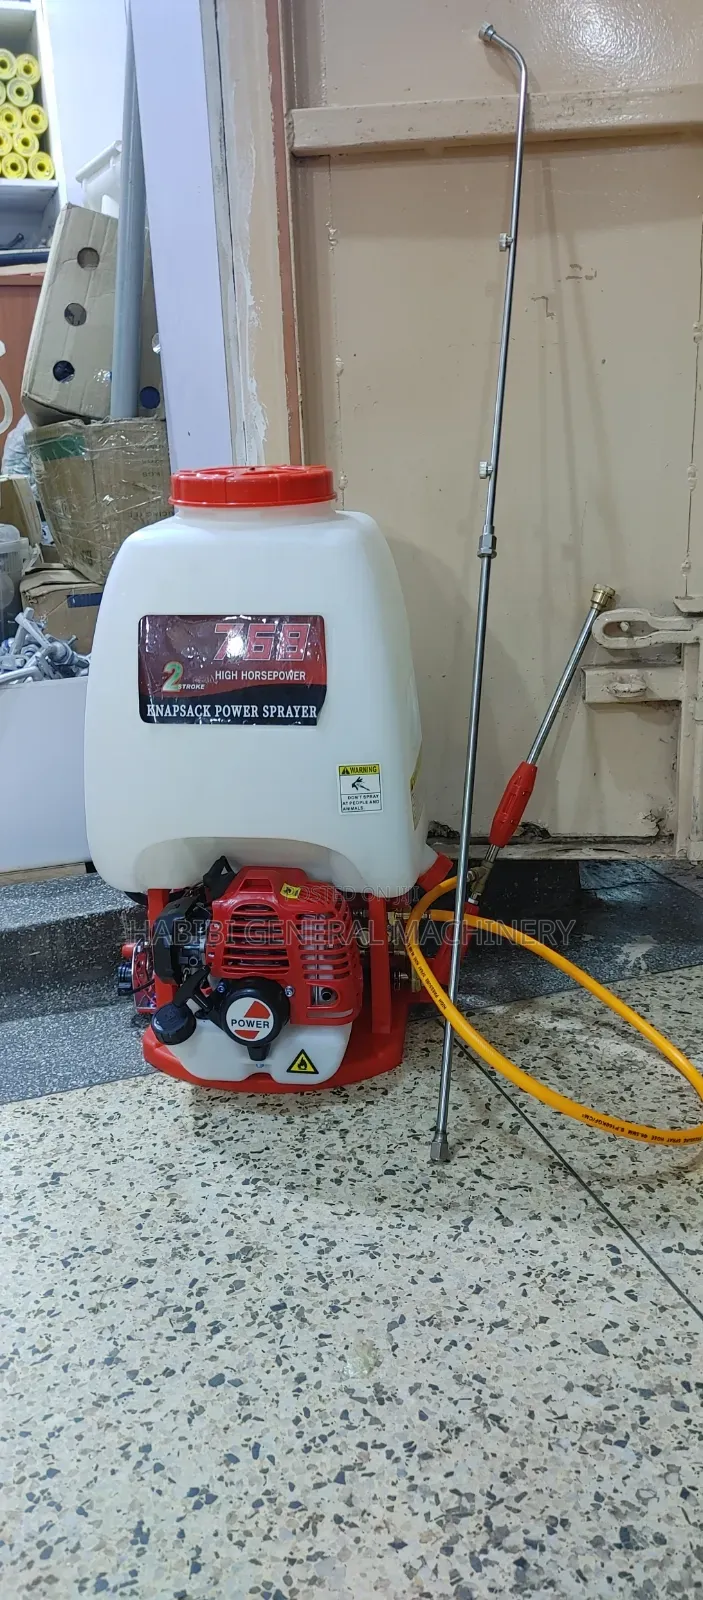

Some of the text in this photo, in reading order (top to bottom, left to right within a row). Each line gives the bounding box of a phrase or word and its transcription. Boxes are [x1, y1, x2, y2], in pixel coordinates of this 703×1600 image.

[162, 661, 184, 692] 2
[215, 670, 306, 681] HIGH HORSEPOWER
[146, 704, 318, 719] KNAPSACK POWER SPRAYER
[350, 765, 377, 774] WARNING
[231, 1019, 270, 1029] POWER
